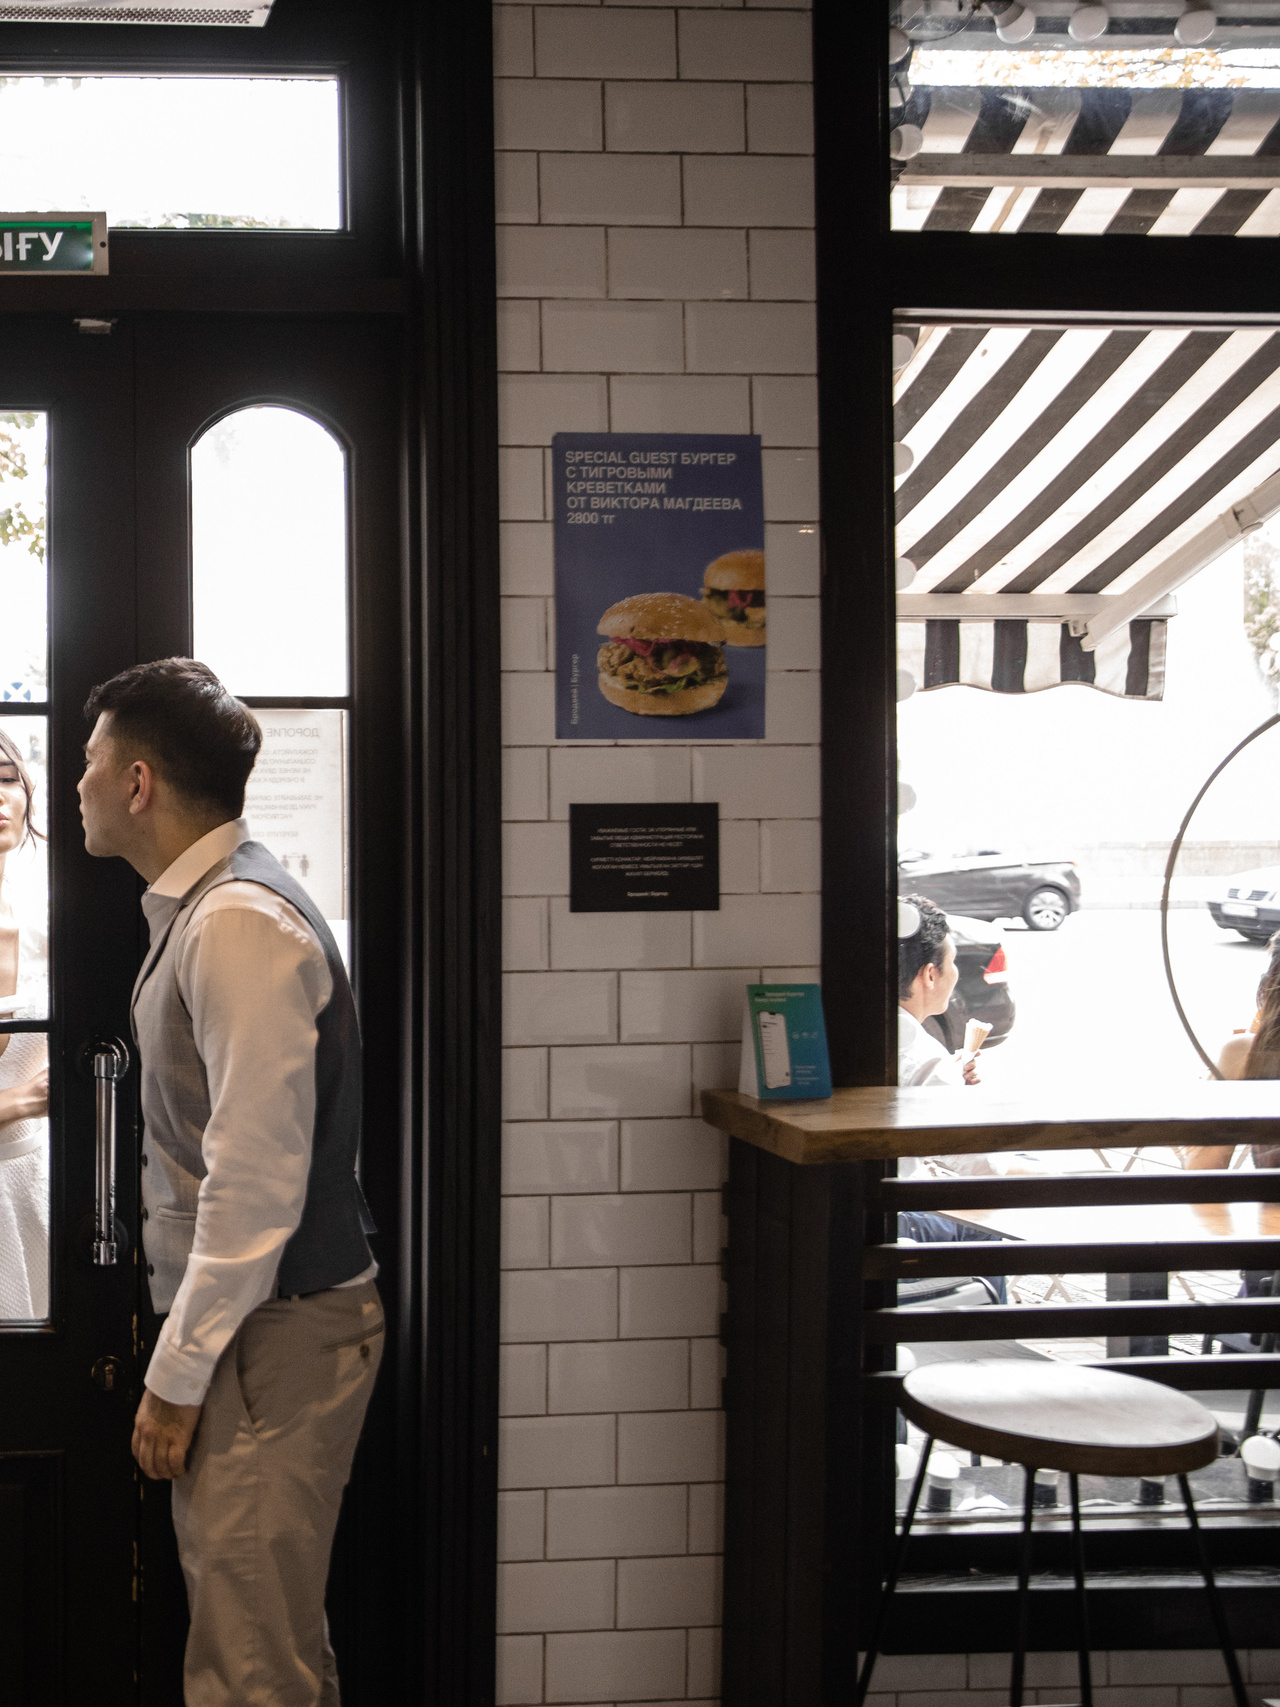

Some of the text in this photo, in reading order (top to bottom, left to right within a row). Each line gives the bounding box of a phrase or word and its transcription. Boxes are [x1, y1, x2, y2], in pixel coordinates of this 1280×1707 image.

[565, 451, 737, 465] SPECIAL GUEST БУРГЕР
[565, 466, 673, 479] С ТИГРОВЫМИ
[566, 481, 667, 494] КРЕВЕТКАМИ
[566, 496, 743, 511] ОТ ВИКТОРА МАГДЕЕВА
[566, 511, 599, 524] 2800
